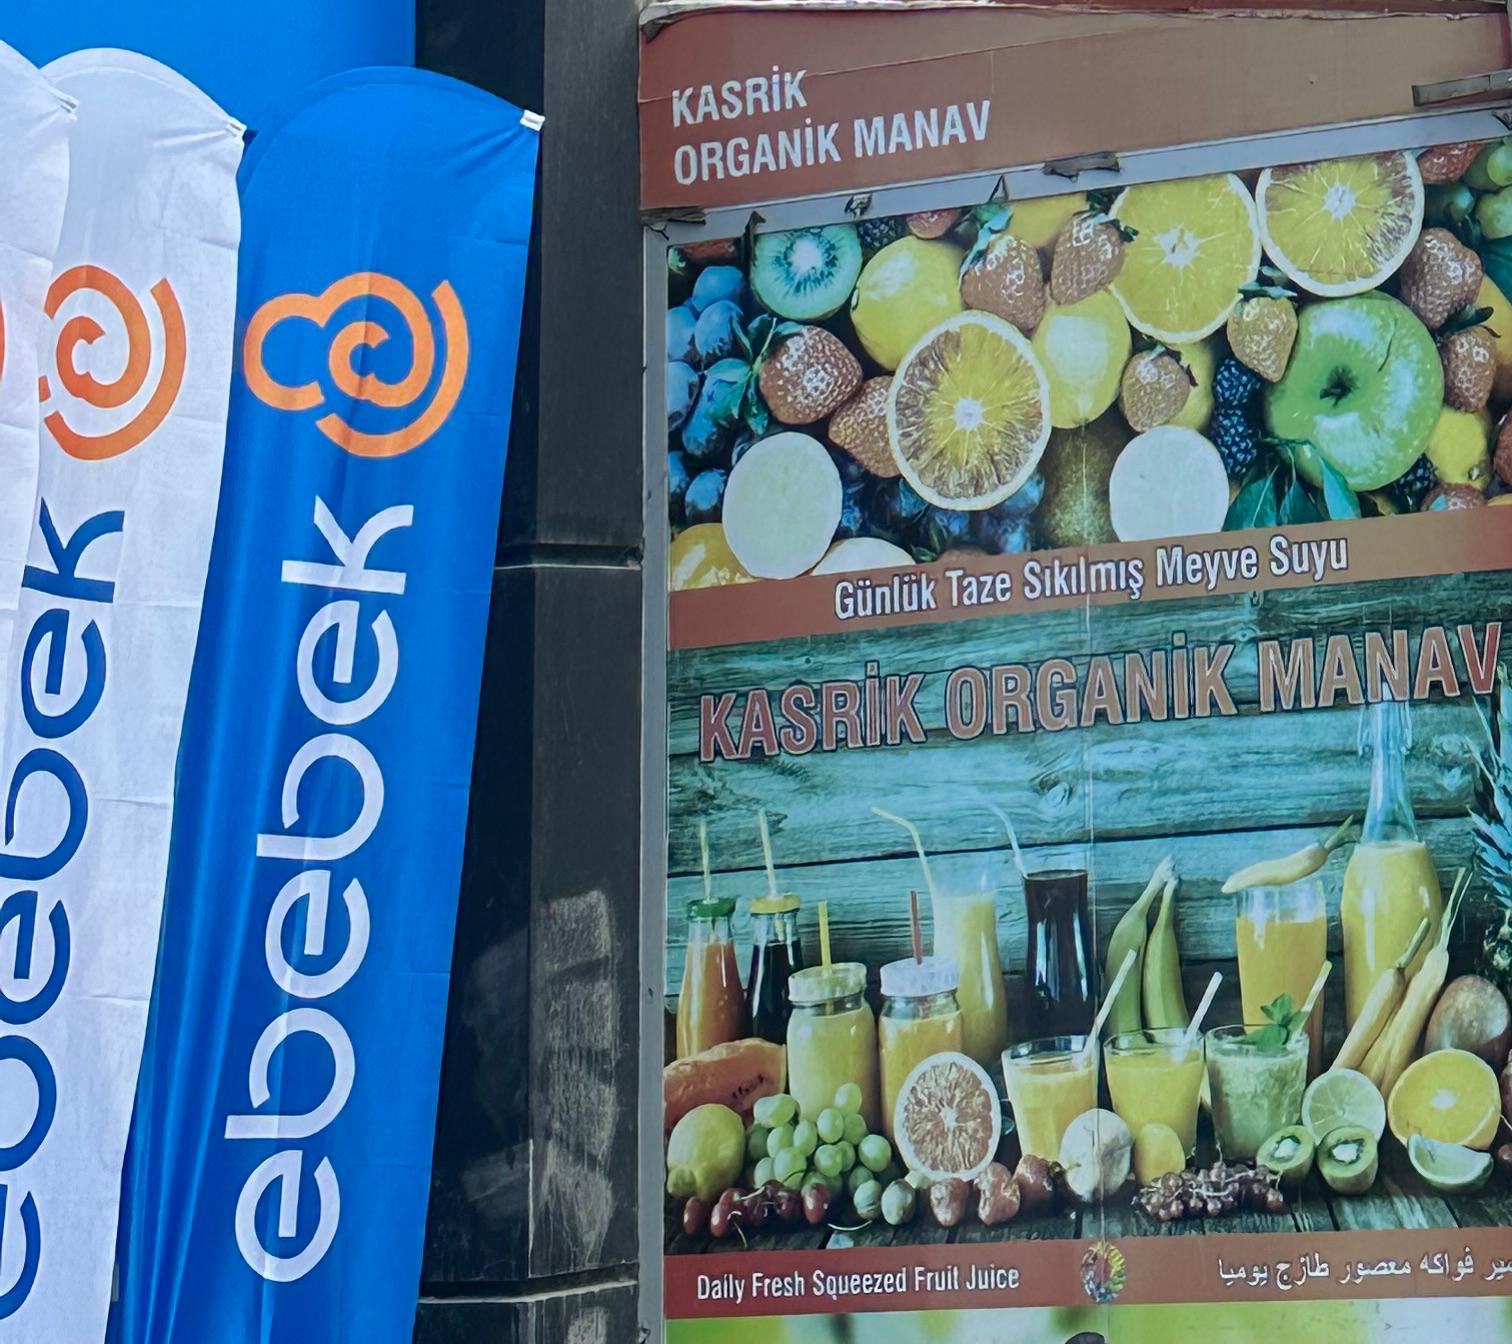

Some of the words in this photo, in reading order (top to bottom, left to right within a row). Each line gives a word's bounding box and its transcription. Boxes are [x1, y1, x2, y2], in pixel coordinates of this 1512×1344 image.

[672, 65, 807, 127] KASRİK
[674, 118, 841, 185] ORGANİK
[853, 100, 990, 158] MANAV
[834, 571, 936, 620] Günlük
[945, 568, 1012, 607] Taze
[1023, 556, 1144, 600] Sıkılmış
[1156, 547, 1258, 591] Meyve
[1270, 534, 1348, 581] Suyu
[699, 661, 927, 761] KASRİK
[947, 632, 1236, 738] ORGANİK
[1258, 622, 1501, 713] MANAV
[225, 496, 413, 1281] ebebek
[697, 1273, 745, 1304] Daily
[752, 1269, 804, 1298] Fresh
[812, 1266, 906, 1301] Squeezed
[914, 1265, 959, 1292] Fruit
[966, 1264, 1019, 1290] Juice
[1275, 1252, 1329, 1291] طازج
[1338, 1259, 1411, 1285] معصور
[1419, 1247, 1474, 1282] فواكه
